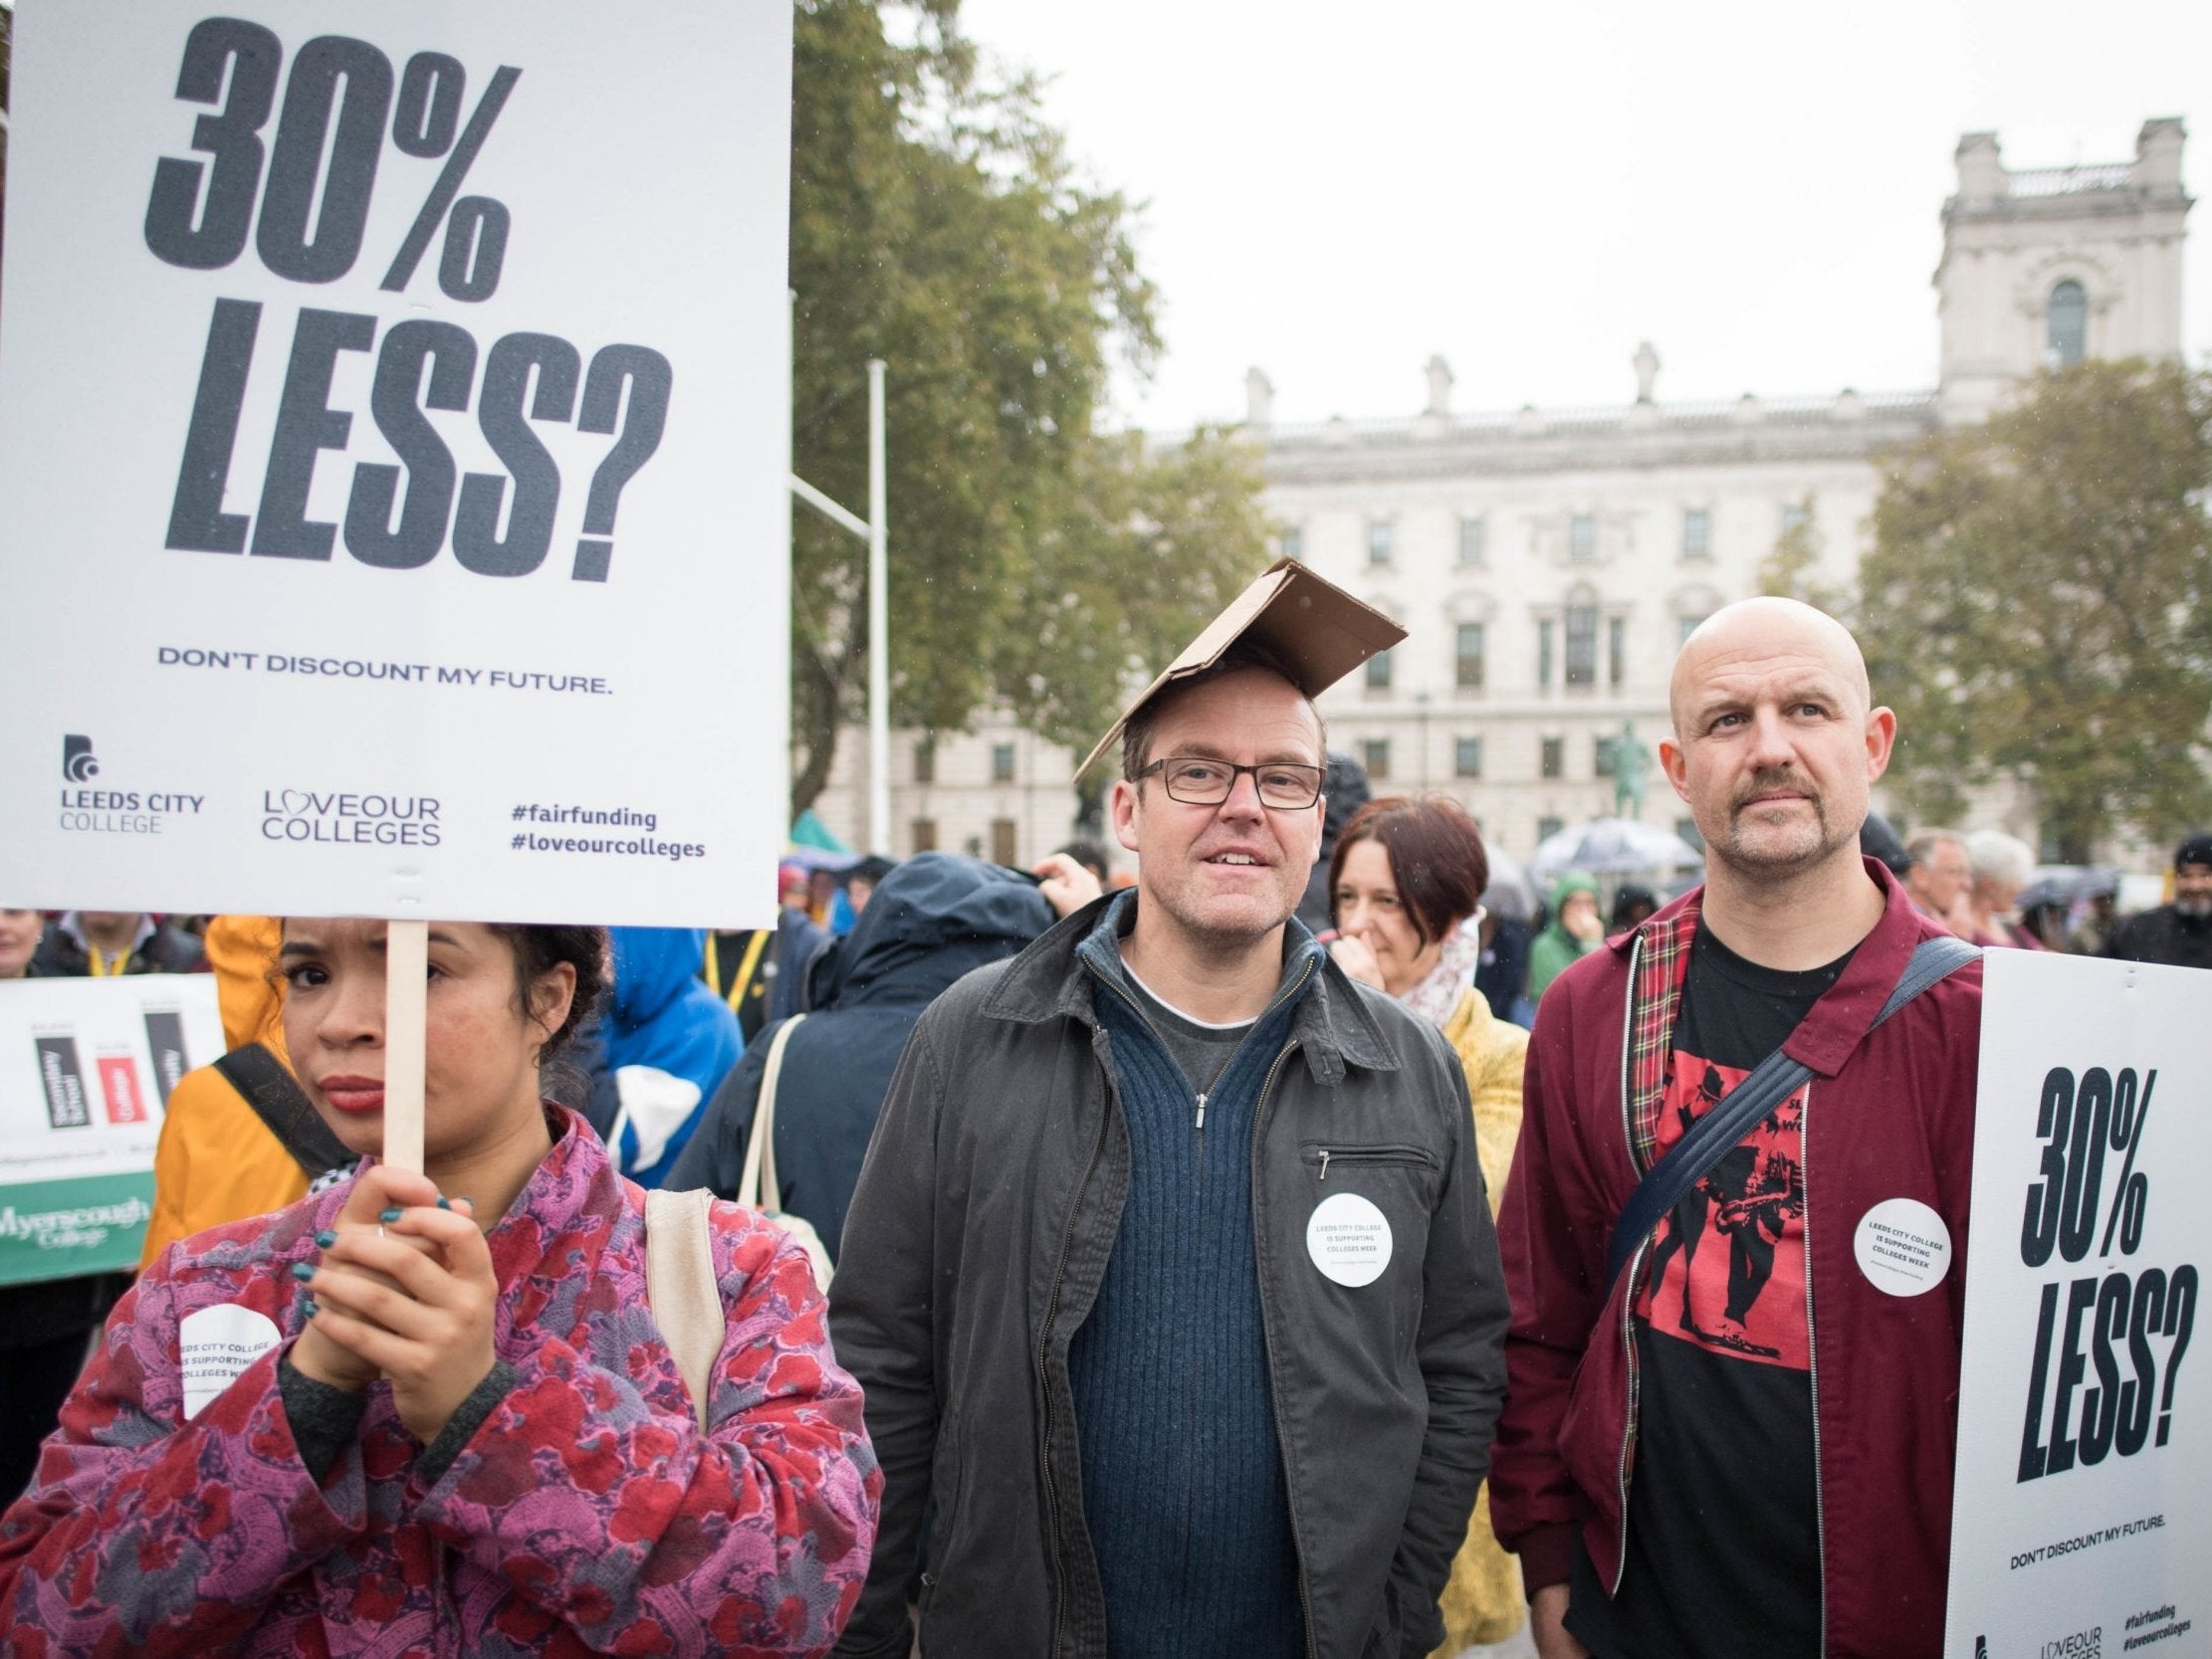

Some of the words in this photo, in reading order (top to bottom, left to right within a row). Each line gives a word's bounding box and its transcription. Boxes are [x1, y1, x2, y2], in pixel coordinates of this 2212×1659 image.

[144, 16, 524, 303] 30%
[164, 297, 673, 582] LESS?
[158, 647, 259, 670] DON'T
[267, 655, 430, 682] DISCOUNT
[438, 667, 482, 685] MY
[491, 671, 613, 695] FUTURE.
[62, 789, 139, 810] LEEDS
[147, 793, 205, 813] CITY
[60, 812, 162, 834] COLLEGE
[262, 816, 441, 846] COLLEGES
[512, 804, 657, 832] #fairfunding
[511, 833, 706, 861] #loveourcolleges
[2020, 1067, 2158, 1268] 30%
[1869, 1221, 1891, 1234] LEEDS
[1891, 1229, 1909, 1239] CITY
[1910, 1235, 1943, 1251] COLLEGE
[1884, 1237, 1930, 1258] SUPPORTING
[1873, 1245, 1907, 1262] COLLEGES
[1908, 1257, 1930, 1269] WEEK
[201, 1344, 226, 1352] CITY
[228, 1341, 270, 1352] COLLEGE
[182, 1368, 228, 1379] OLLEGES
[2017, 1264, 2199, 1484] LESS?
[2010, 1548, 2046, 1570] DON'T
[2047, 1531, 2103, 1559] DISCOUNT
[2104, 1526, 2121, 1543] MY
[2122, 1515, 2166, 1538] FUTURE.
[2124, 1603, 2176, 1631] #fairfunding
[2123, 1619, 2192, 1652] #loveourcolleges
